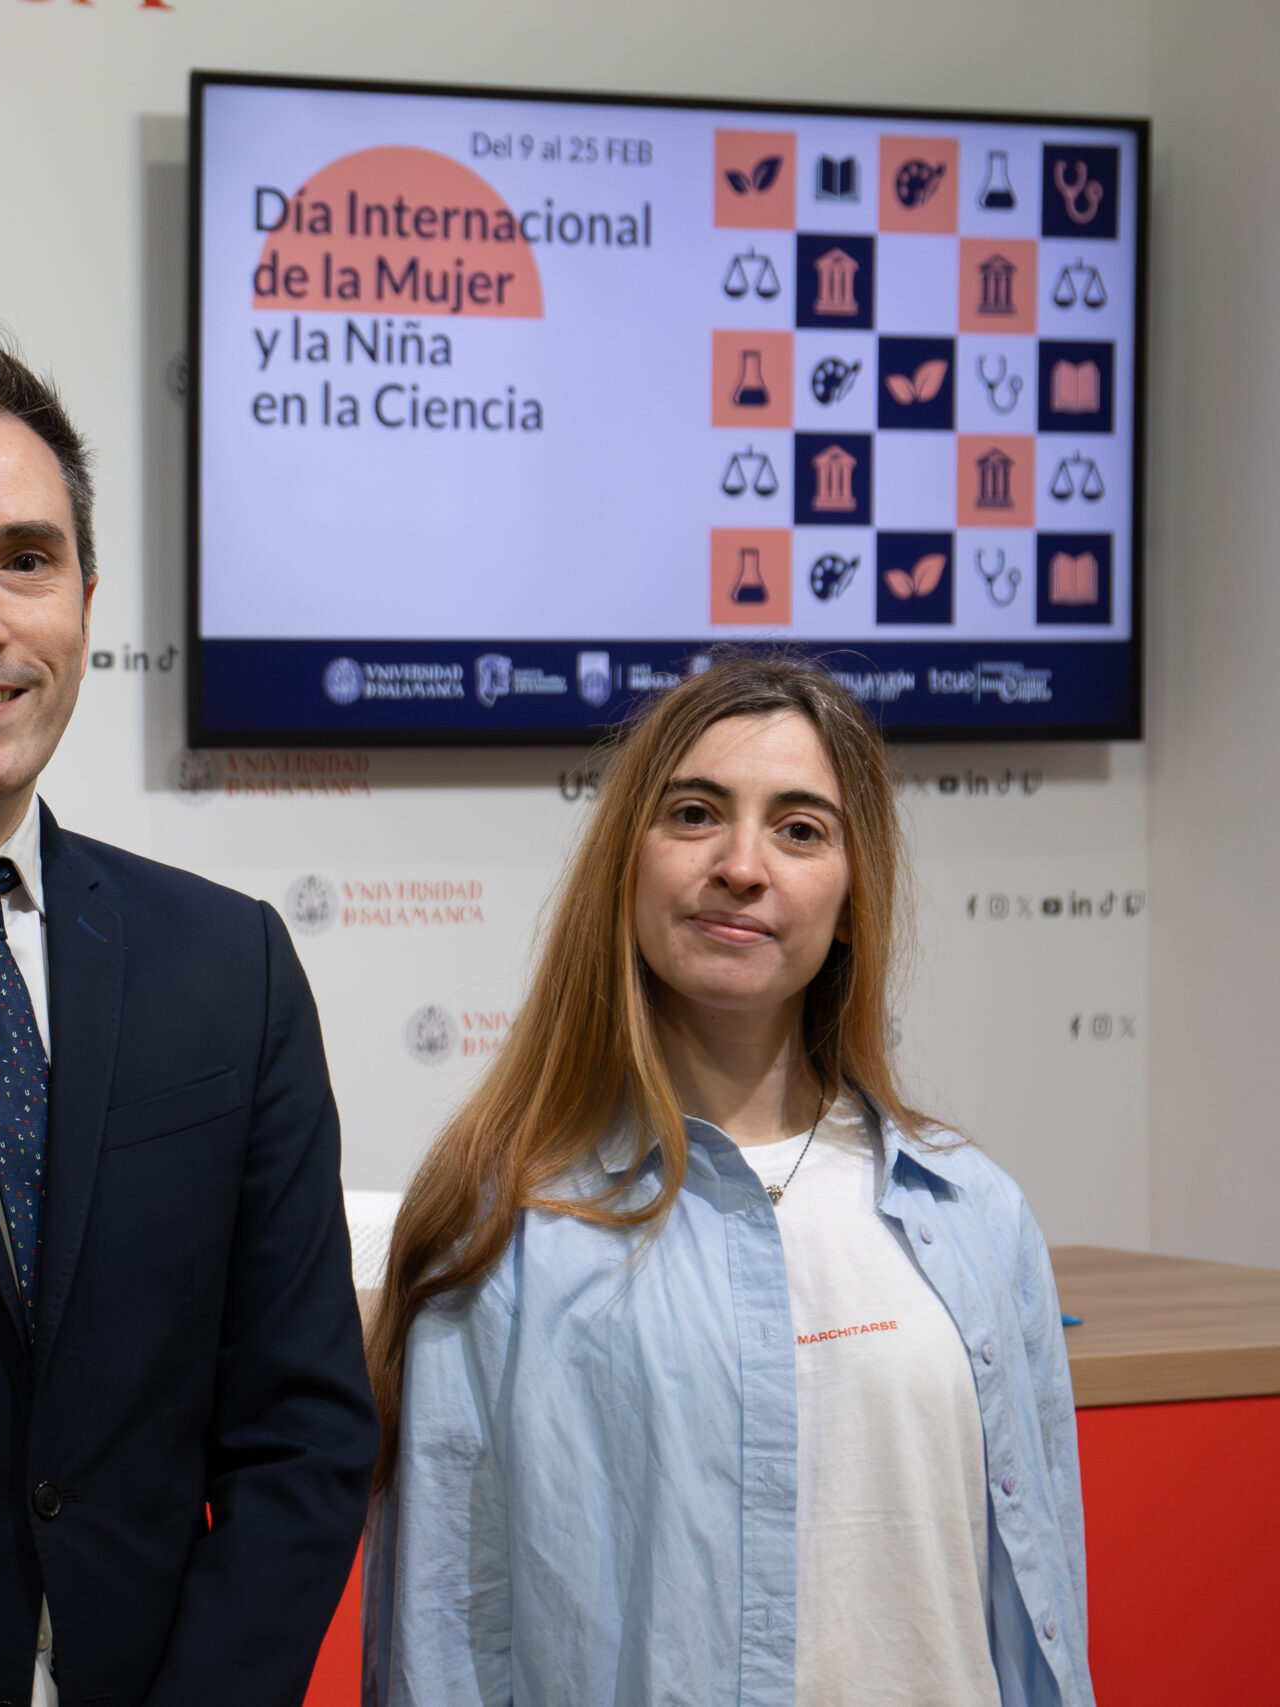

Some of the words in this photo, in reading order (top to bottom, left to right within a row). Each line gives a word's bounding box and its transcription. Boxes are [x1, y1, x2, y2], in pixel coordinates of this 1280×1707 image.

[471, 131, 512, 158] Del
[519, 134, 535, 158] 9
[541, 135, 562, 162] al
[568, 135, 599, 164] 25
[605, 137, 654, 167] FEB
[254, 185, 332, 235] Día
[348, 191, 652, 248] Internacional
[251, 251, 308, 298] de
[324, 253, 360, 300] la
[376, 256, 513, 313] Mujer
[254, 328, 279, 371] y
[292, 316, 329, 363] la
[345, 319, 452, 366] Niña
[251, 392, 307, 426] en
[322, 381, 359, 428] la
[373, 383, 543, 431] Ciencia
[797, 1320, 898, 1346] MARCHITARSE
